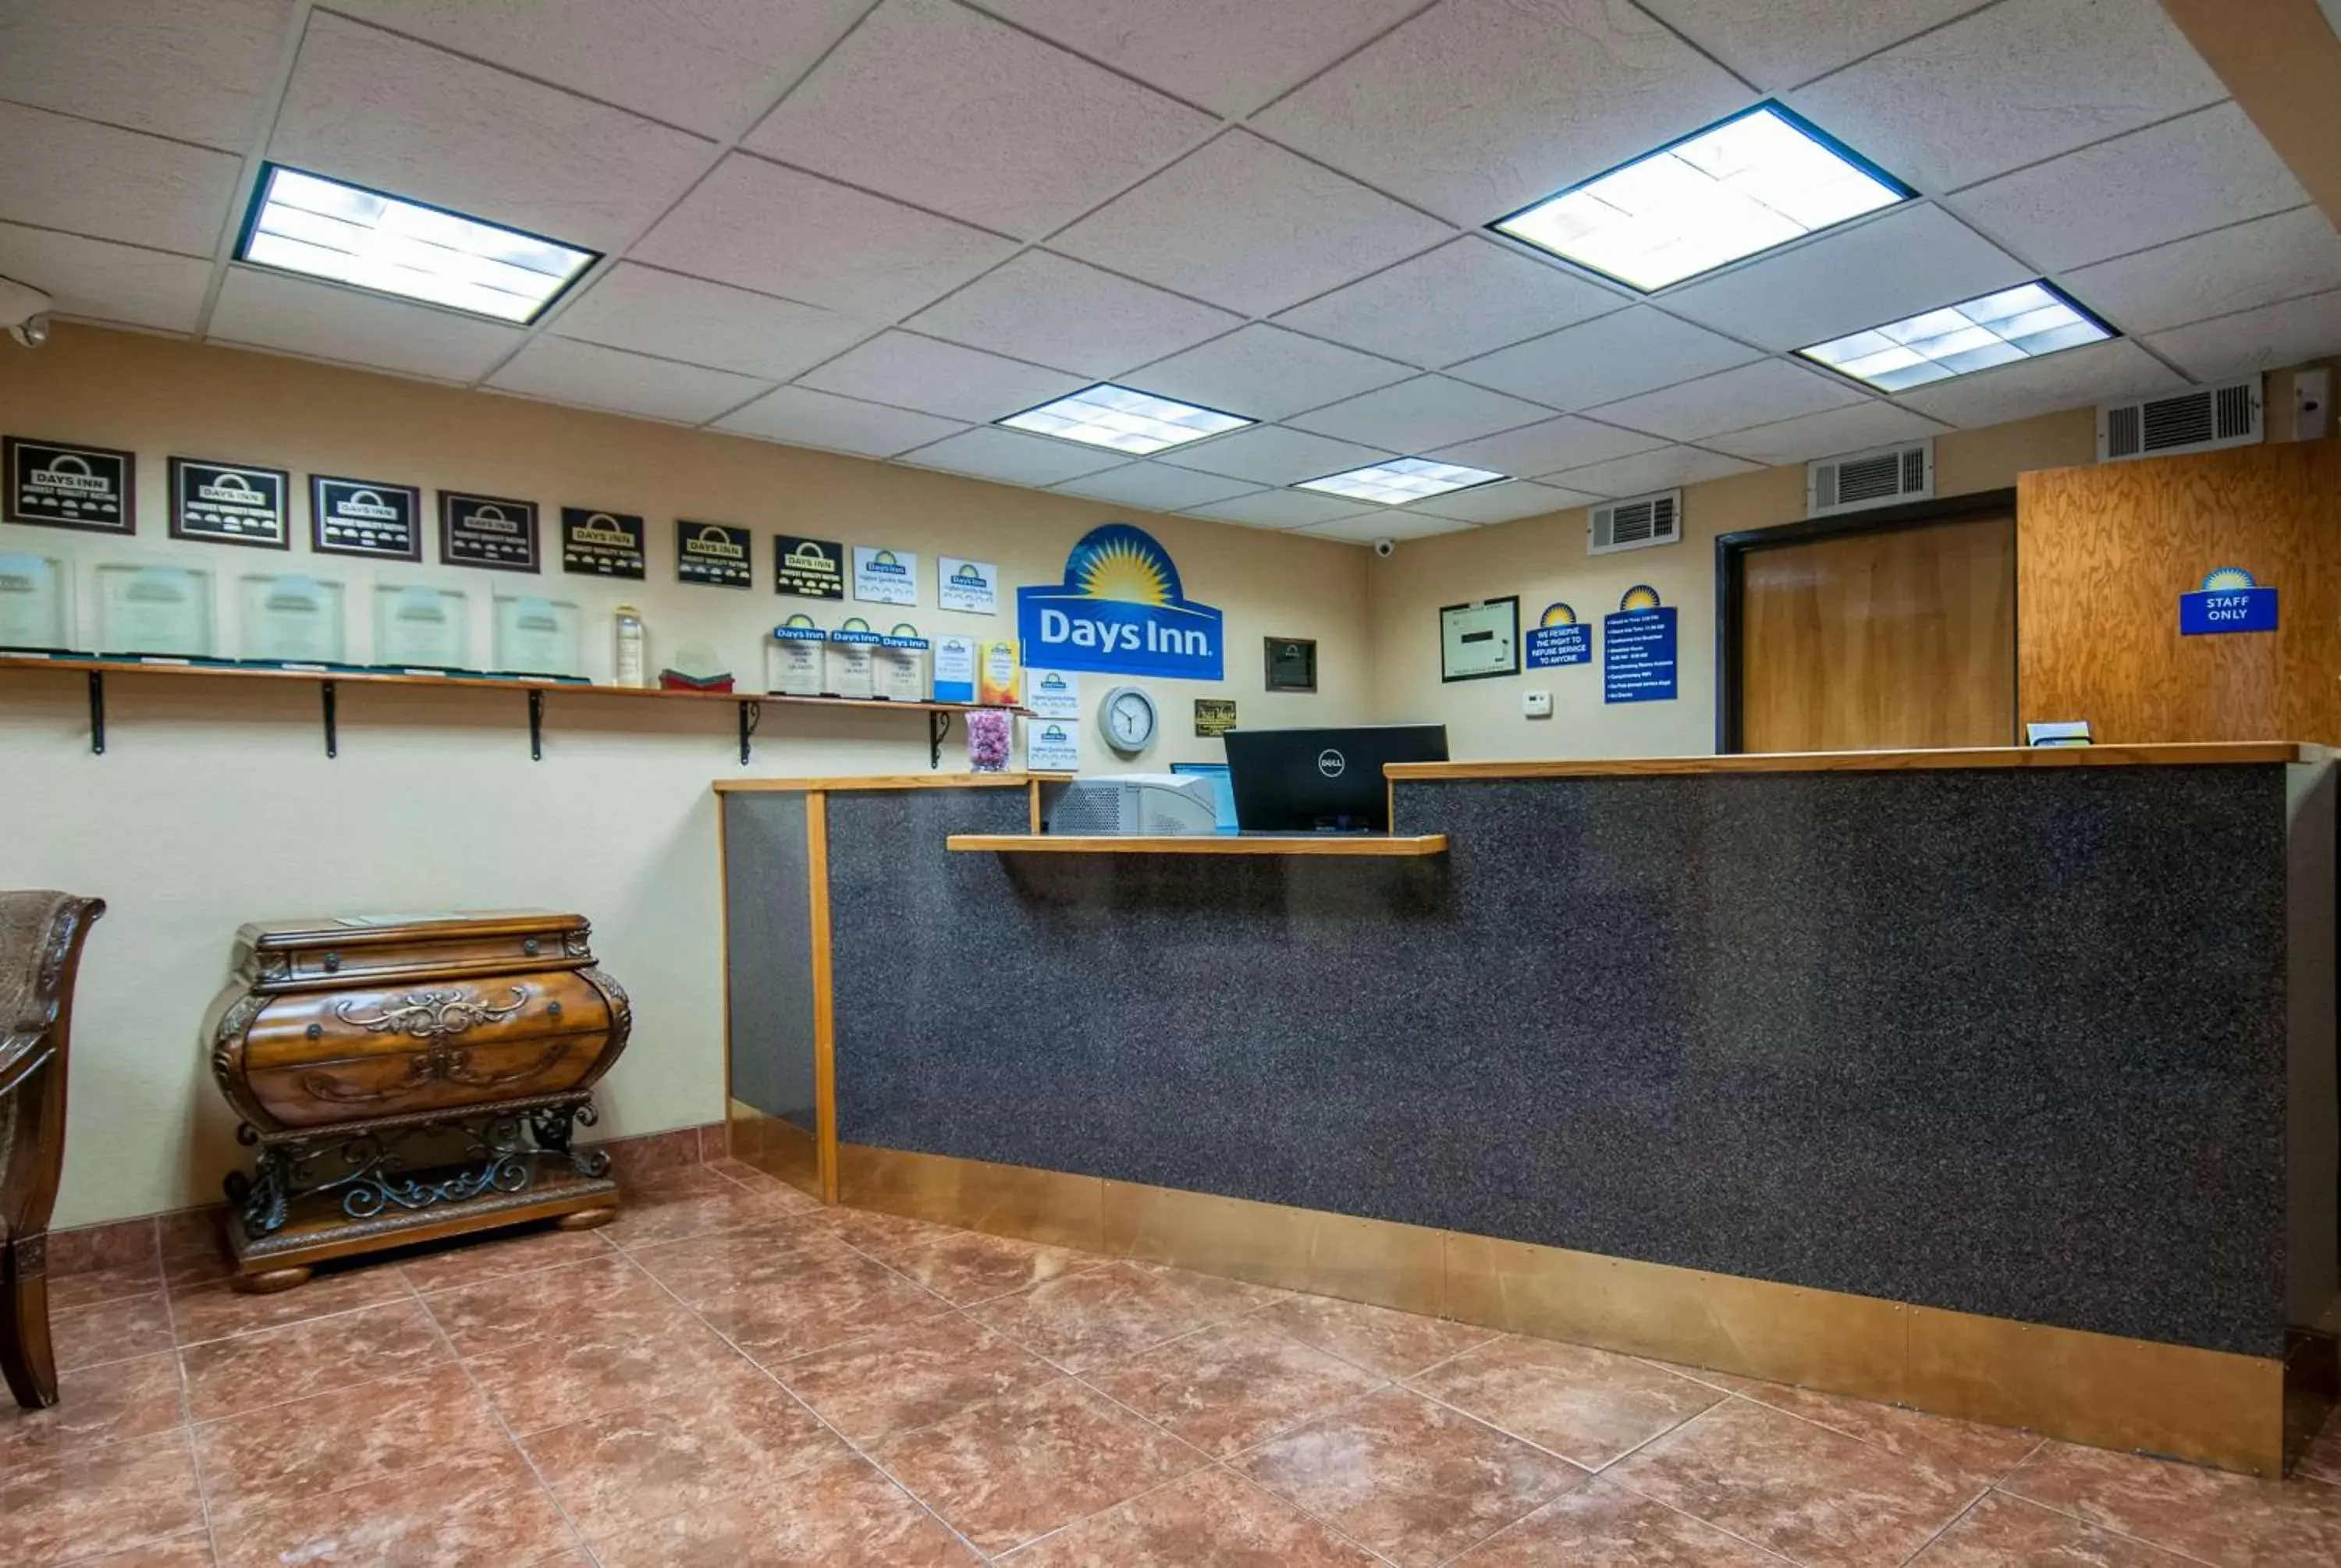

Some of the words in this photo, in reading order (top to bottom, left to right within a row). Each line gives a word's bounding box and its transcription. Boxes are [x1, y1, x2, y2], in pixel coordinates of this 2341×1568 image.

[37, 473, 74, 485] DAYS
[76, 477, 104, 488] INN
[204, 488, 234, 498] DAYS
[236, 492, 259, 501] INN
[577, 530, 606, 541] DAYS
[609, 534, 631, 544] INN
[690, 542, 717, 552] DAYS
[719, 545, 739, 555] INN
[788, 556, 812, 566] DAYS
[814, 560, 832, 569] INN
[2207, 596, 2250, 608] STAFF
[2208, 609, 2247, 620] ONLY
[777, 629, 804, 640] Days
[805, 630, 824, 640] Inn
[1041, 608, 1140, 652] Days
[1550, 626, 1580, 637] RESERVE
[833, 633, 860, 643] Days
[861, 634, 879, 643] Inn
[883, 638, 908, 648] Days
[909, 640, 926, 648] Inn
[1550, 637, 1570, 645] RIGHT
[1532, 647, 1557, 657] REFUSE
[1558, 644, 1586, 655] SERVICE
[1551, 655, 1578, 663] ANYONE
